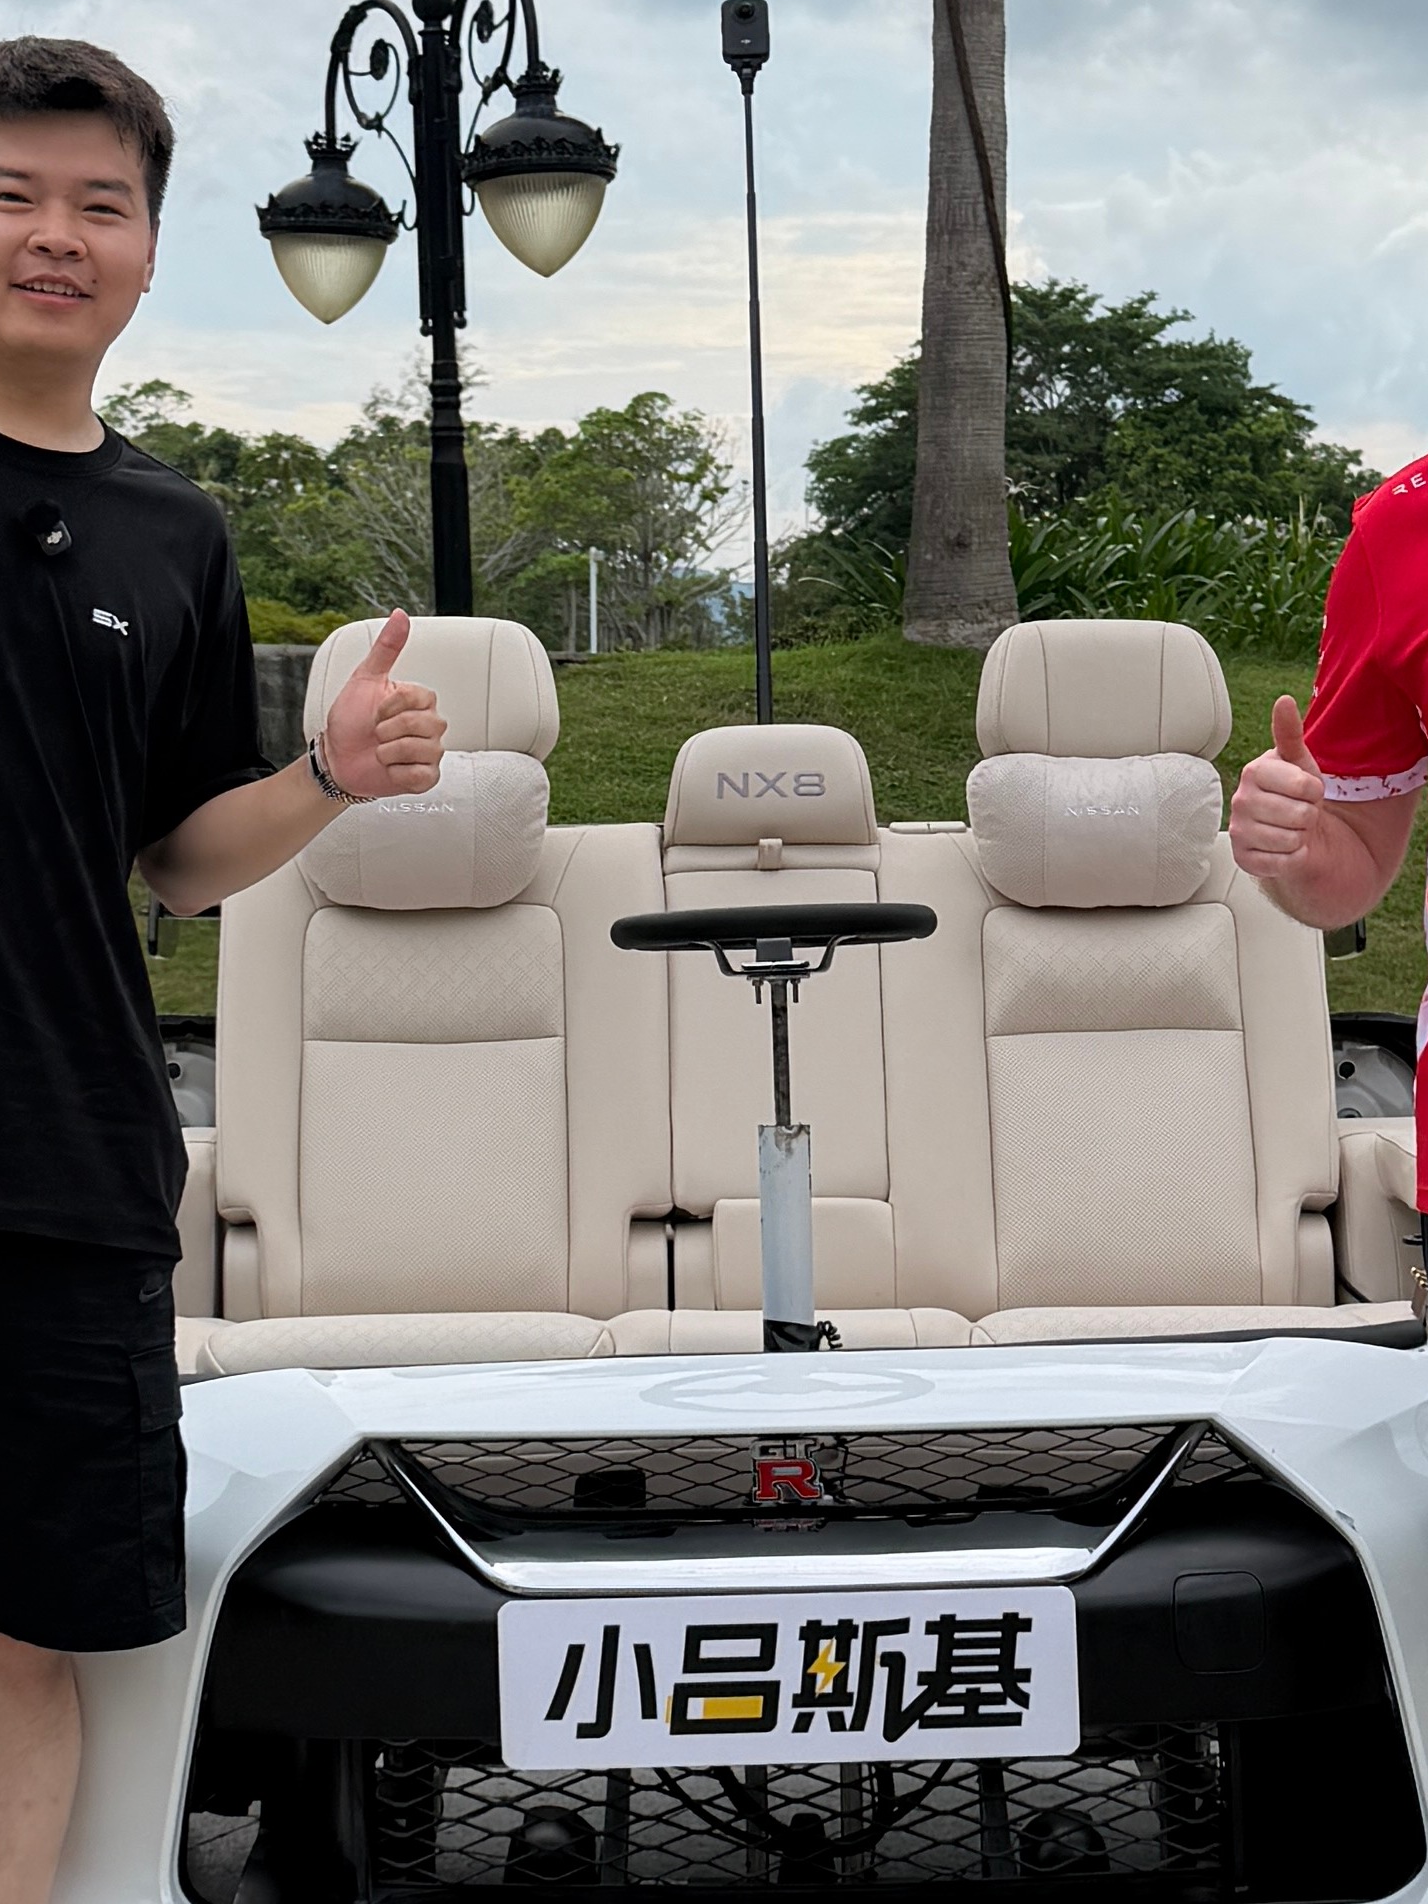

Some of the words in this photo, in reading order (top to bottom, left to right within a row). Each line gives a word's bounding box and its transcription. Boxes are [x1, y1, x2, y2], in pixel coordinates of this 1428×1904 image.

[716, 771, 826, 799] NX8
[378, 802, 454, 813] NISSAN
[1065, 806, 1140, 817] NISSAN
[754, 1459, 822, 1501] R
[544, 1612, 1033, 1743] 小吕斯基
